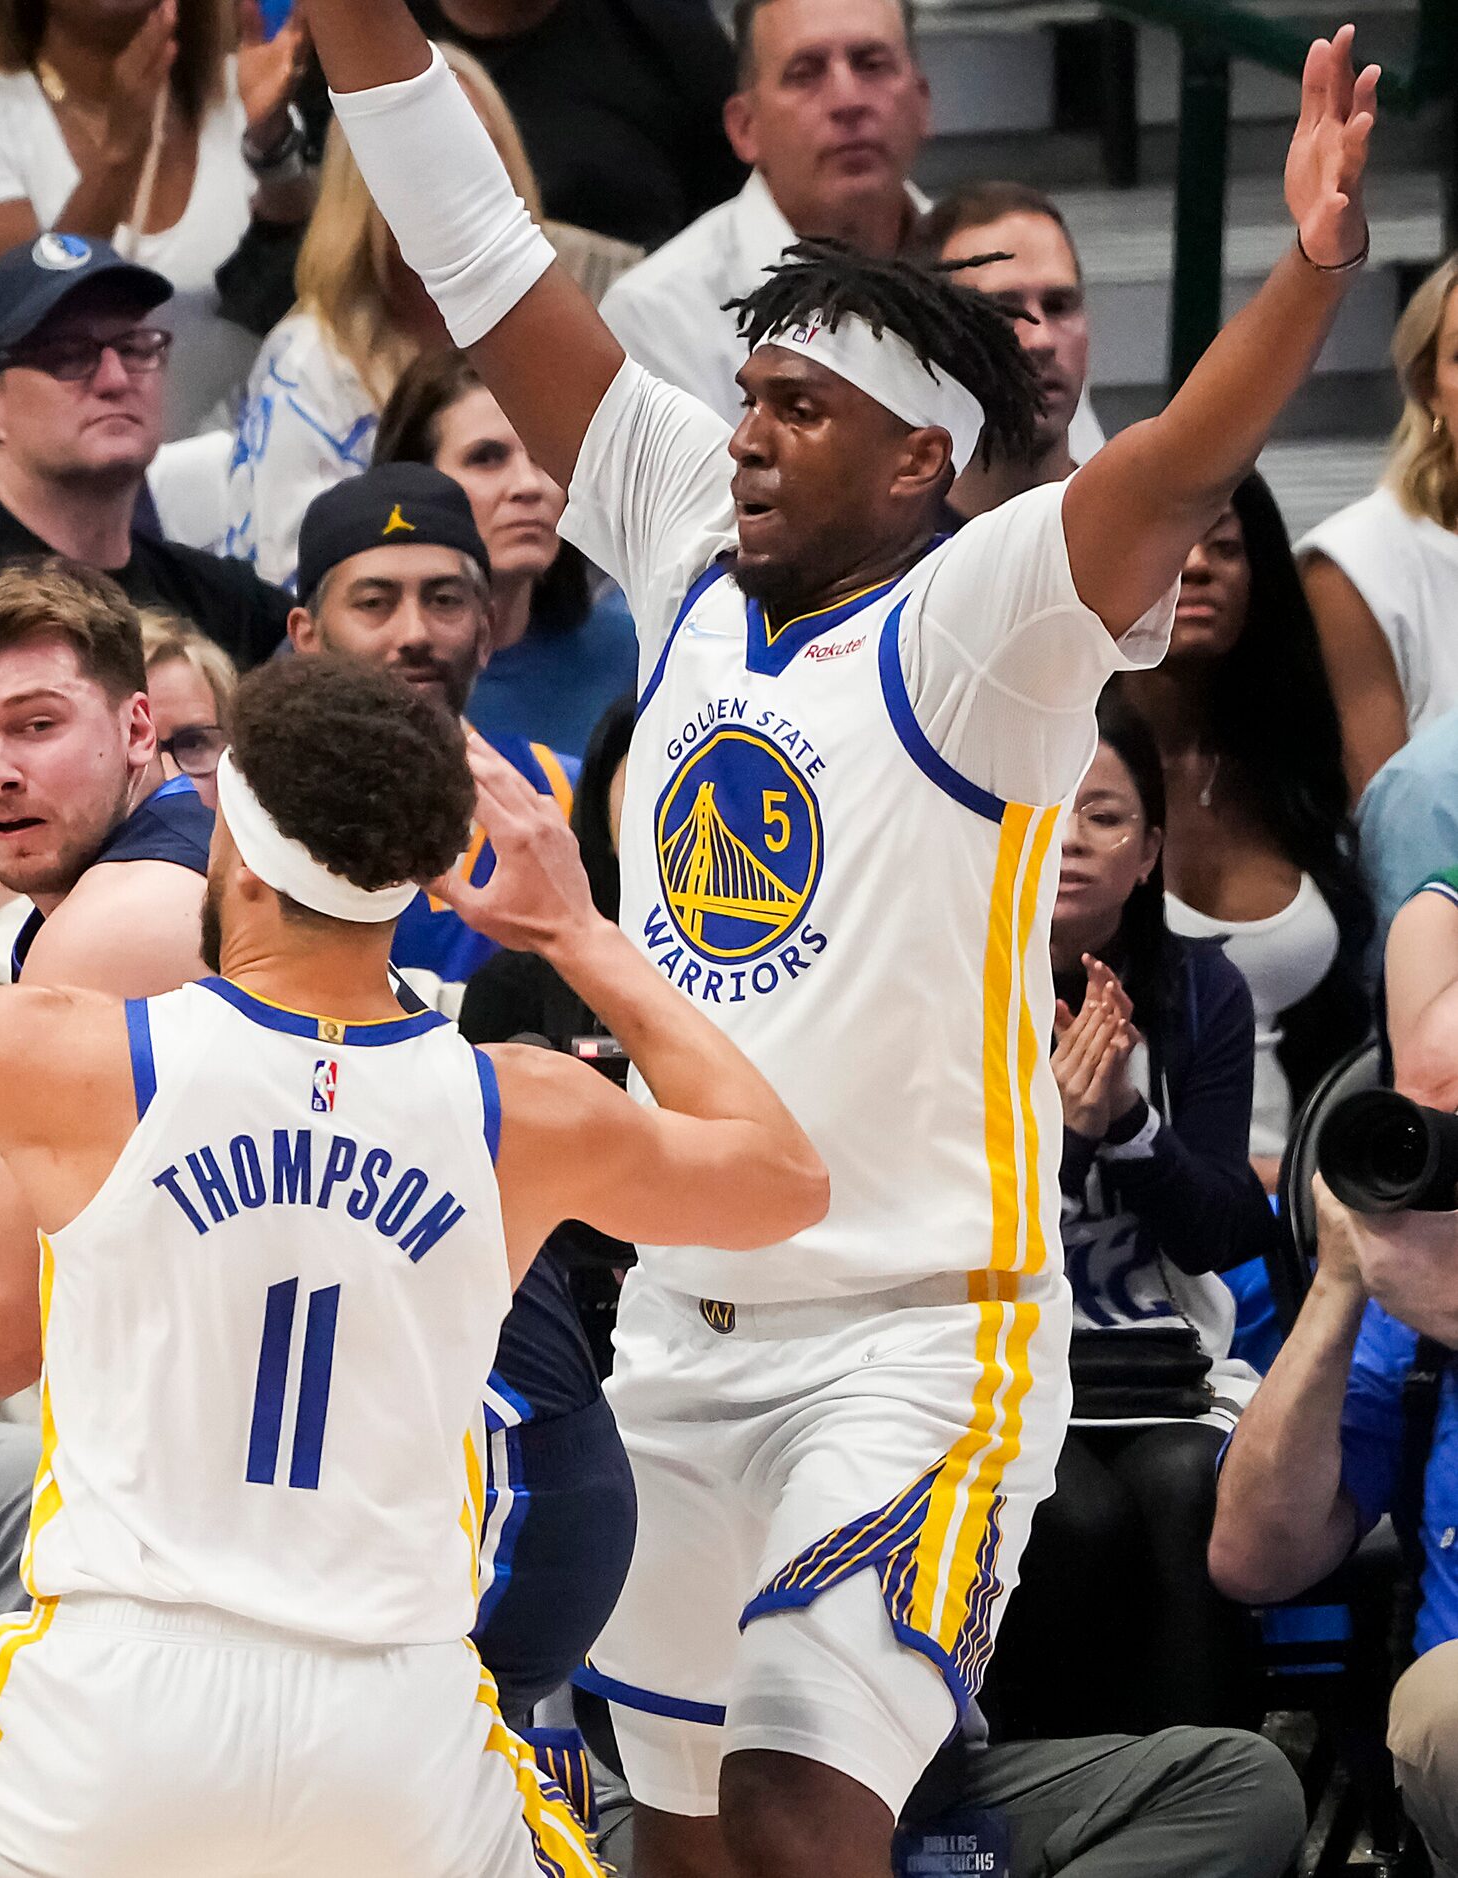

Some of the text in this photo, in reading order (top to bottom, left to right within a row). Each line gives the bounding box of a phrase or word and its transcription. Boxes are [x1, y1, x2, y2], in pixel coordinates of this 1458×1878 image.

[804, 635, 867, 660] Rakuten
[667, 697, 827, 780] GOLDEN STATE
[761, 789, 792, 853] 5
[643, 903, 829, 1004] WARRIORS
[152, 1129, 467, 1264] THOMPSON
[245, 1276, 341, 1491] 11
